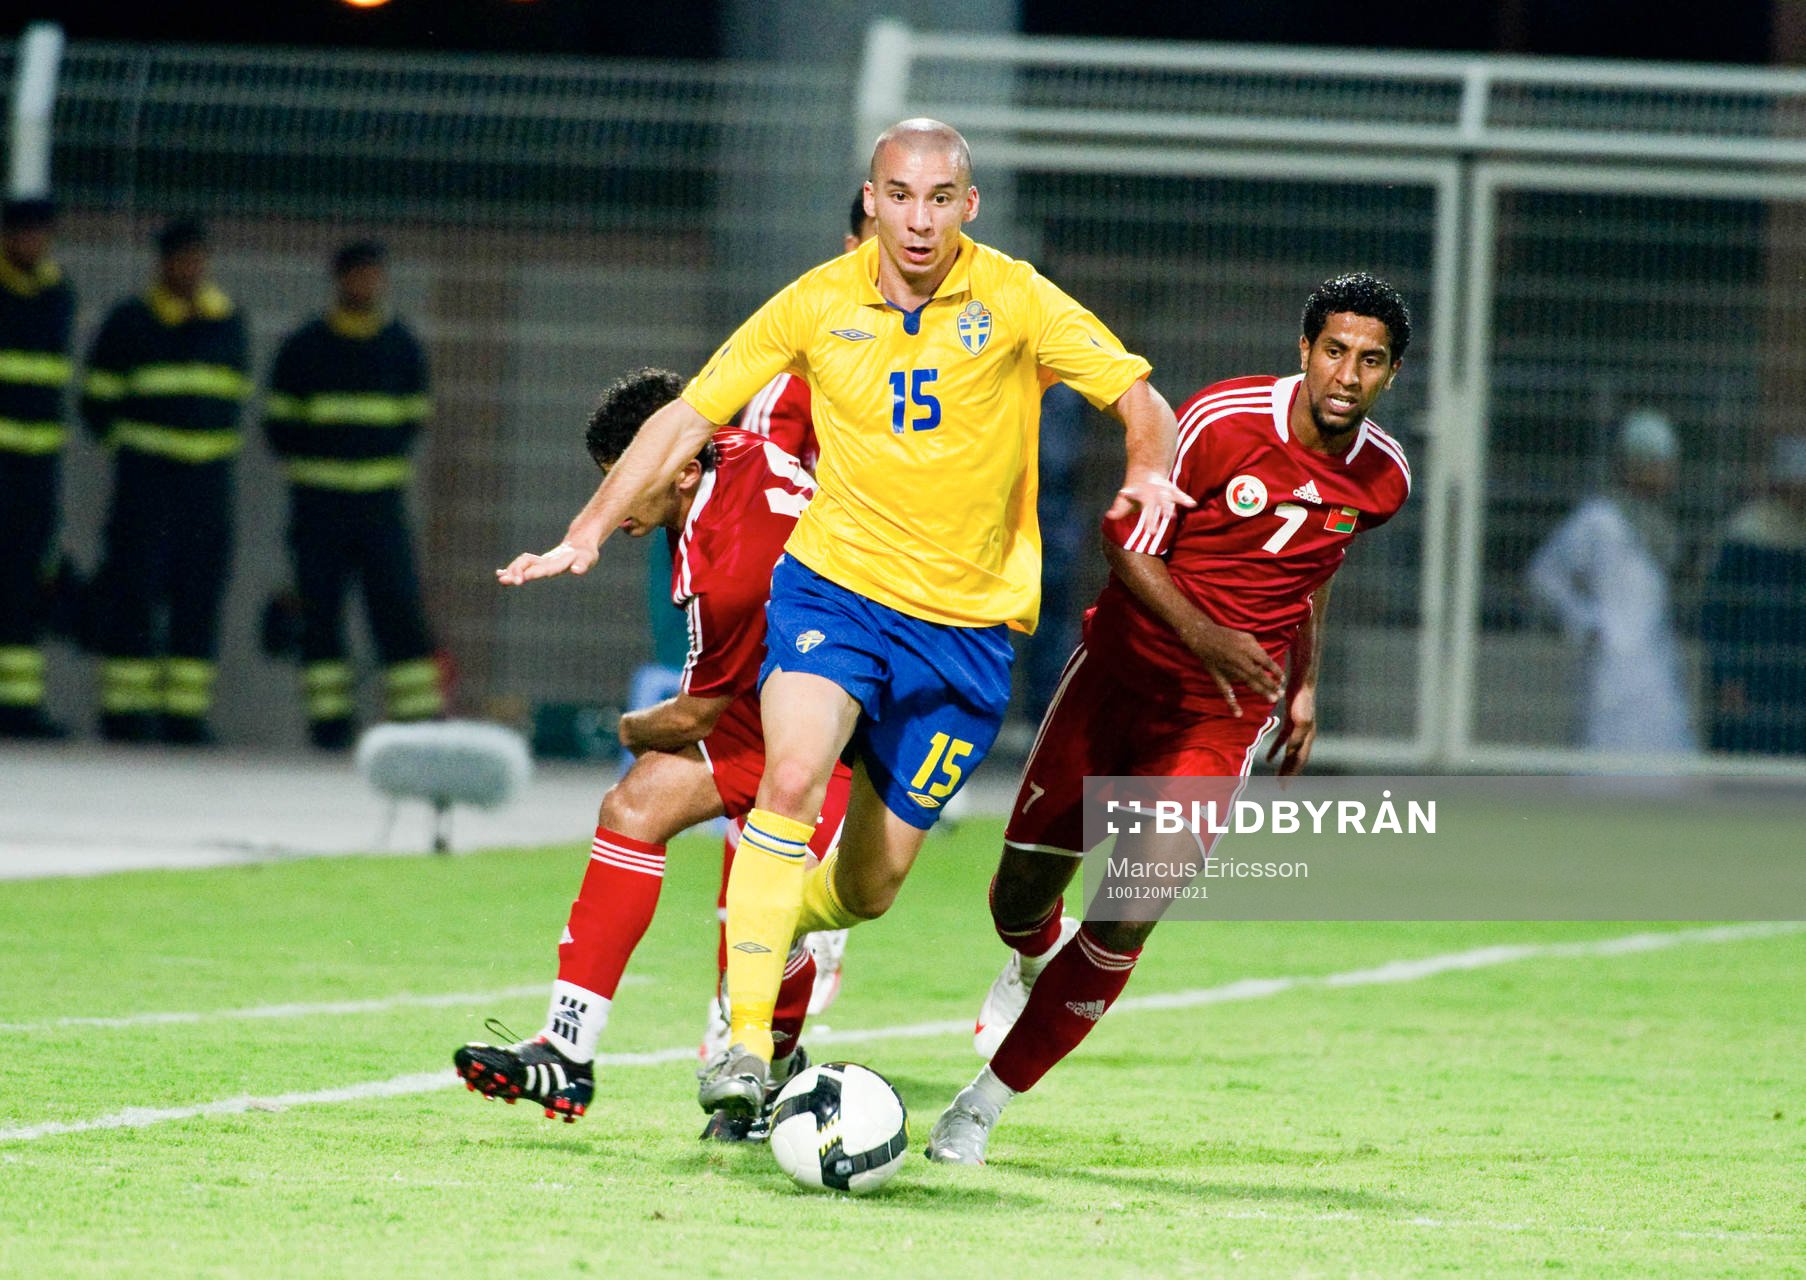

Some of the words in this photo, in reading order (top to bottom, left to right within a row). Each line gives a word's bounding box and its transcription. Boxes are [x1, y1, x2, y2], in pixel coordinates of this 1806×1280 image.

[888, 368, 942, 434] 15
[1292, 488, 1323, 505] adidas
[1262, 502, 1308, 554] 7
[910, 731, 974, 799] 15
[1022, 780, 1046, 815] 7
